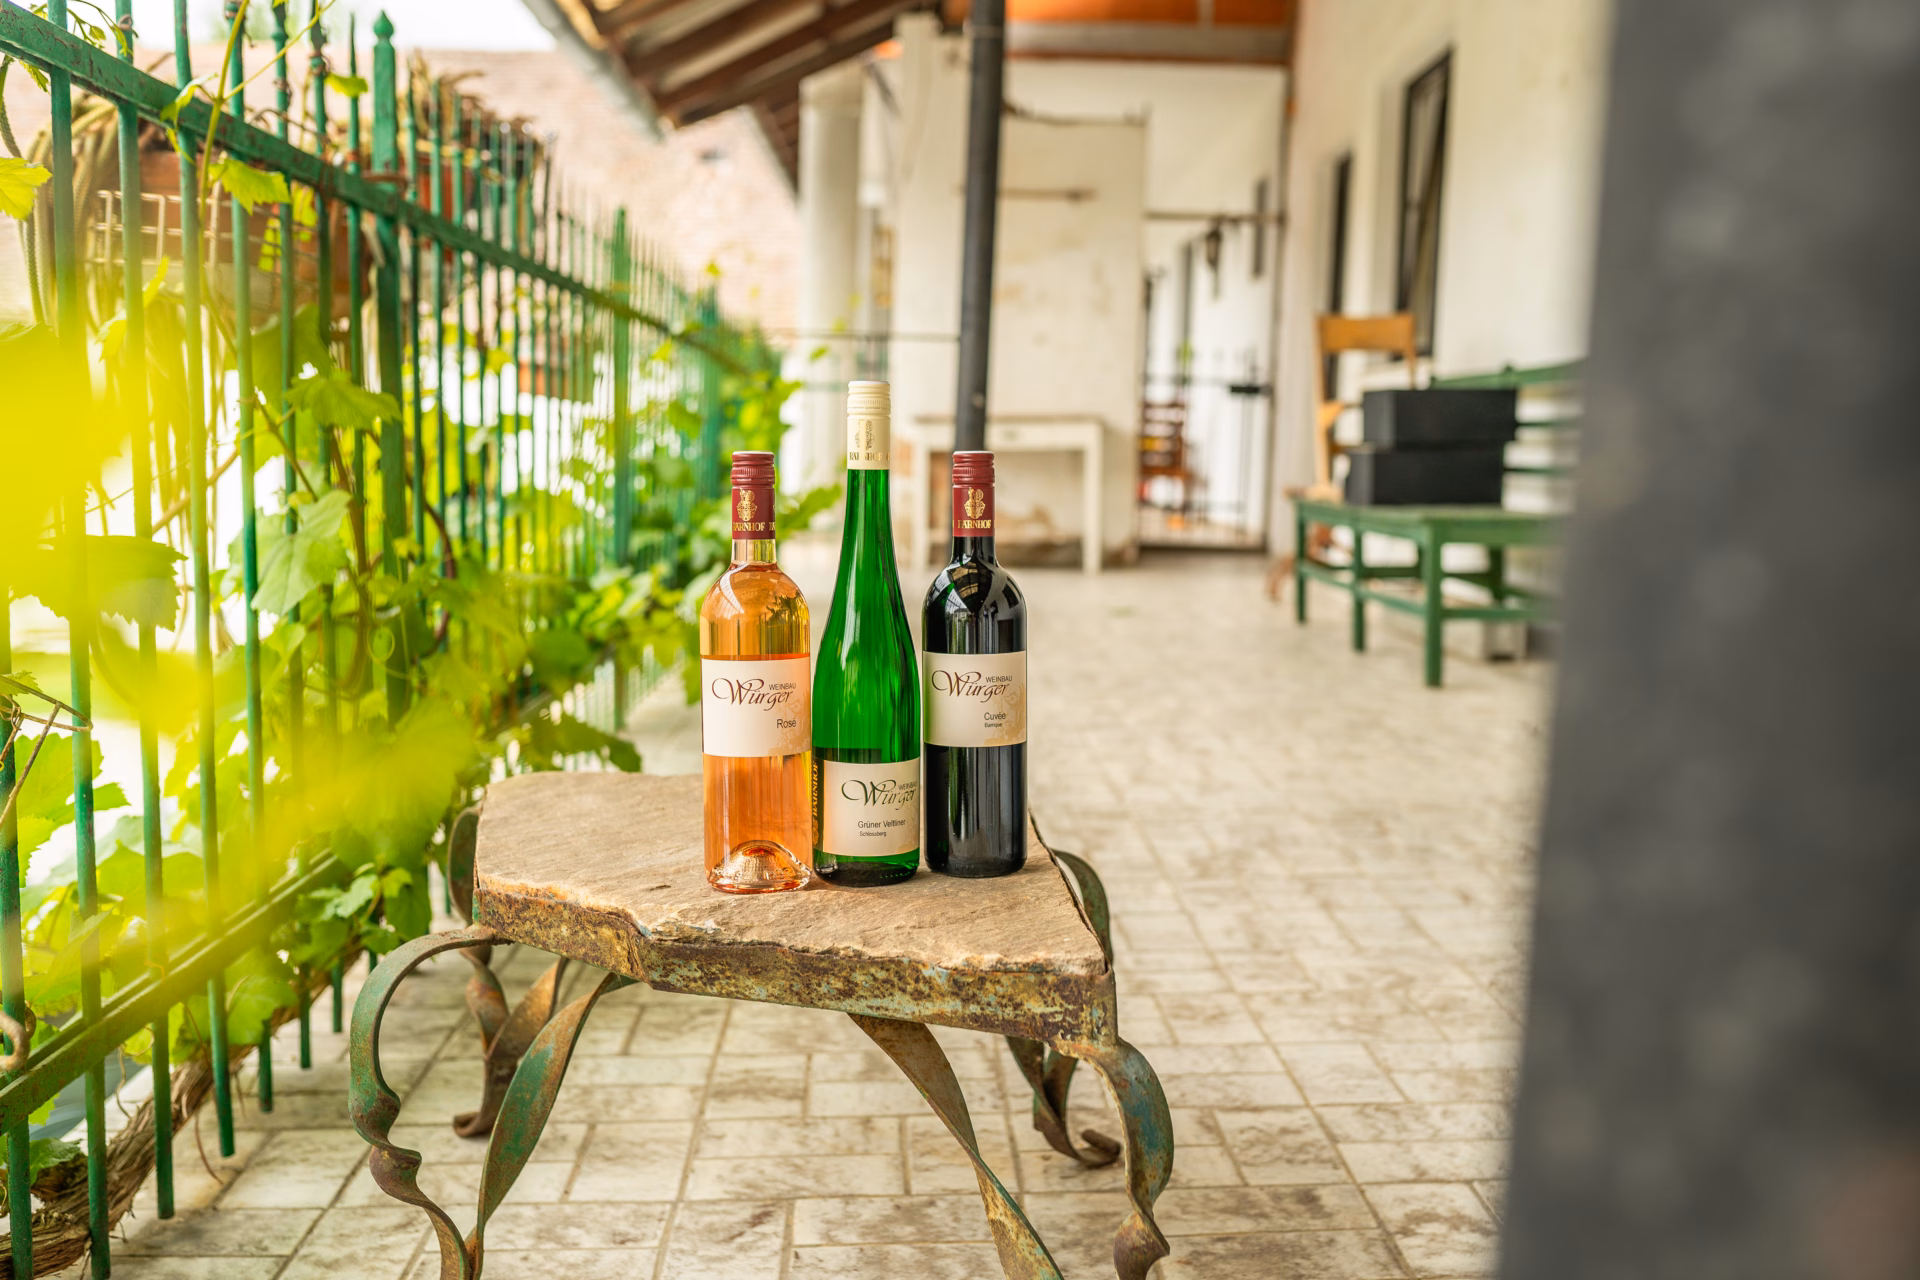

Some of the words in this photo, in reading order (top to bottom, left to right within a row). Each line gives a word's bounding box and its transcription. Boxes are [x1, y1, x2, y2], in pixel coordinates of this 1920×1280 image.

[985, 675, 1013, 683] WEINBAU
[768, 682, 797, 691] WEINBAU
[931, 669, 1010, 703] Würger
[711, 677, 794, 712] Würger
[983, 711, 1007, 721] Cuvée
[776, 717, 797, 729] Rosé
[841, 778, 918, 811] Würger
[857, 820, 881, 829] Grüner
[882, 818, 907, 828] Veltliner
